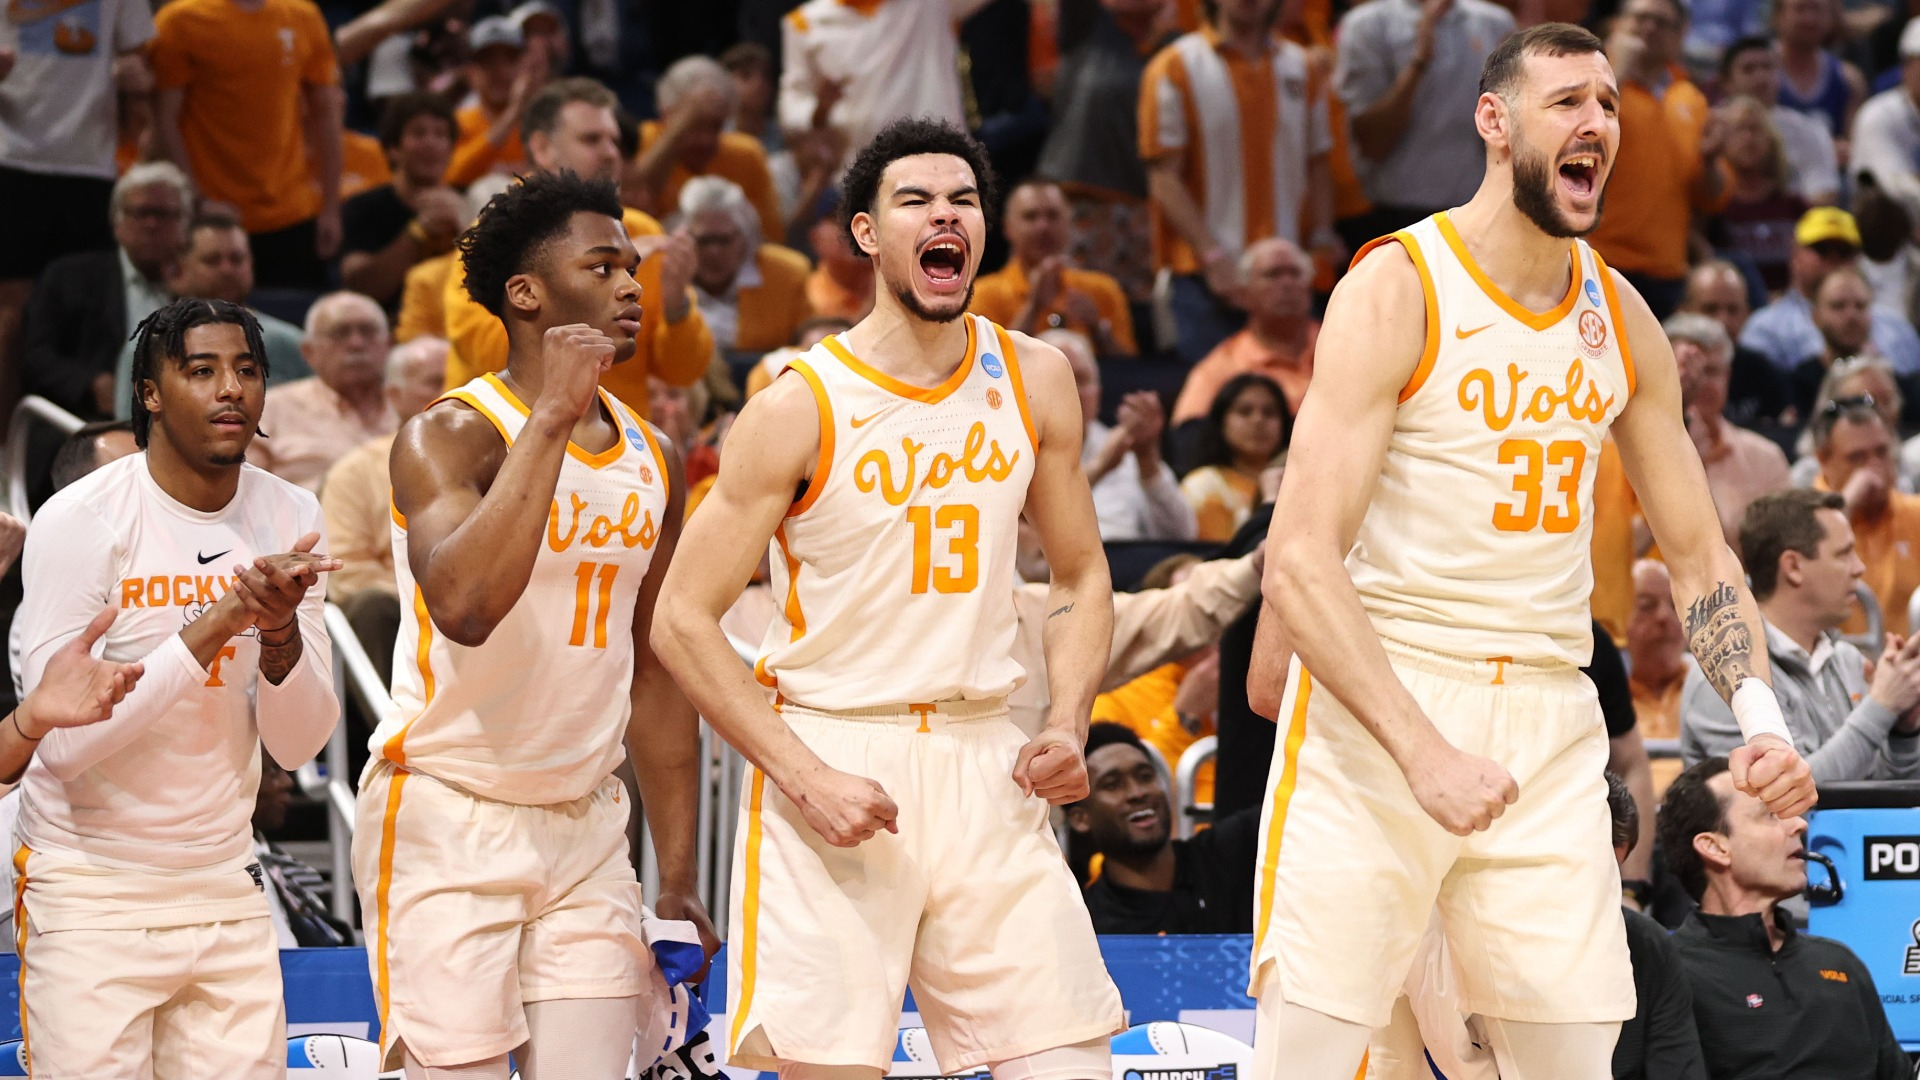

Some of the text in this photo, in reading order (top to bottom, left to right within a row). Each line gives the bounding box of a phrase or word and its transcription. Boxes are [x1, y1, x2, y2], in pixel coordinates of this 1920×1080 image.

[1580, 341, 1609, 358] GRADUATE
[1581, 312, 1605, 346] SEC
[1457, 358, 1614, 431] Vols
[854, 421, 1019, 506] Vols
[1492, 439, 1586, 533] 33
[548, 492, 662, 552] Vols
[906, 504, 980, 594] 13
[121, 575, 240, 608] ROCKY
[569, 562, 619, 648] 11
[1486, 655, 1513, 685] T
[908, 703, 937, 732] T
[1870, 842, 1920, 873] PO
